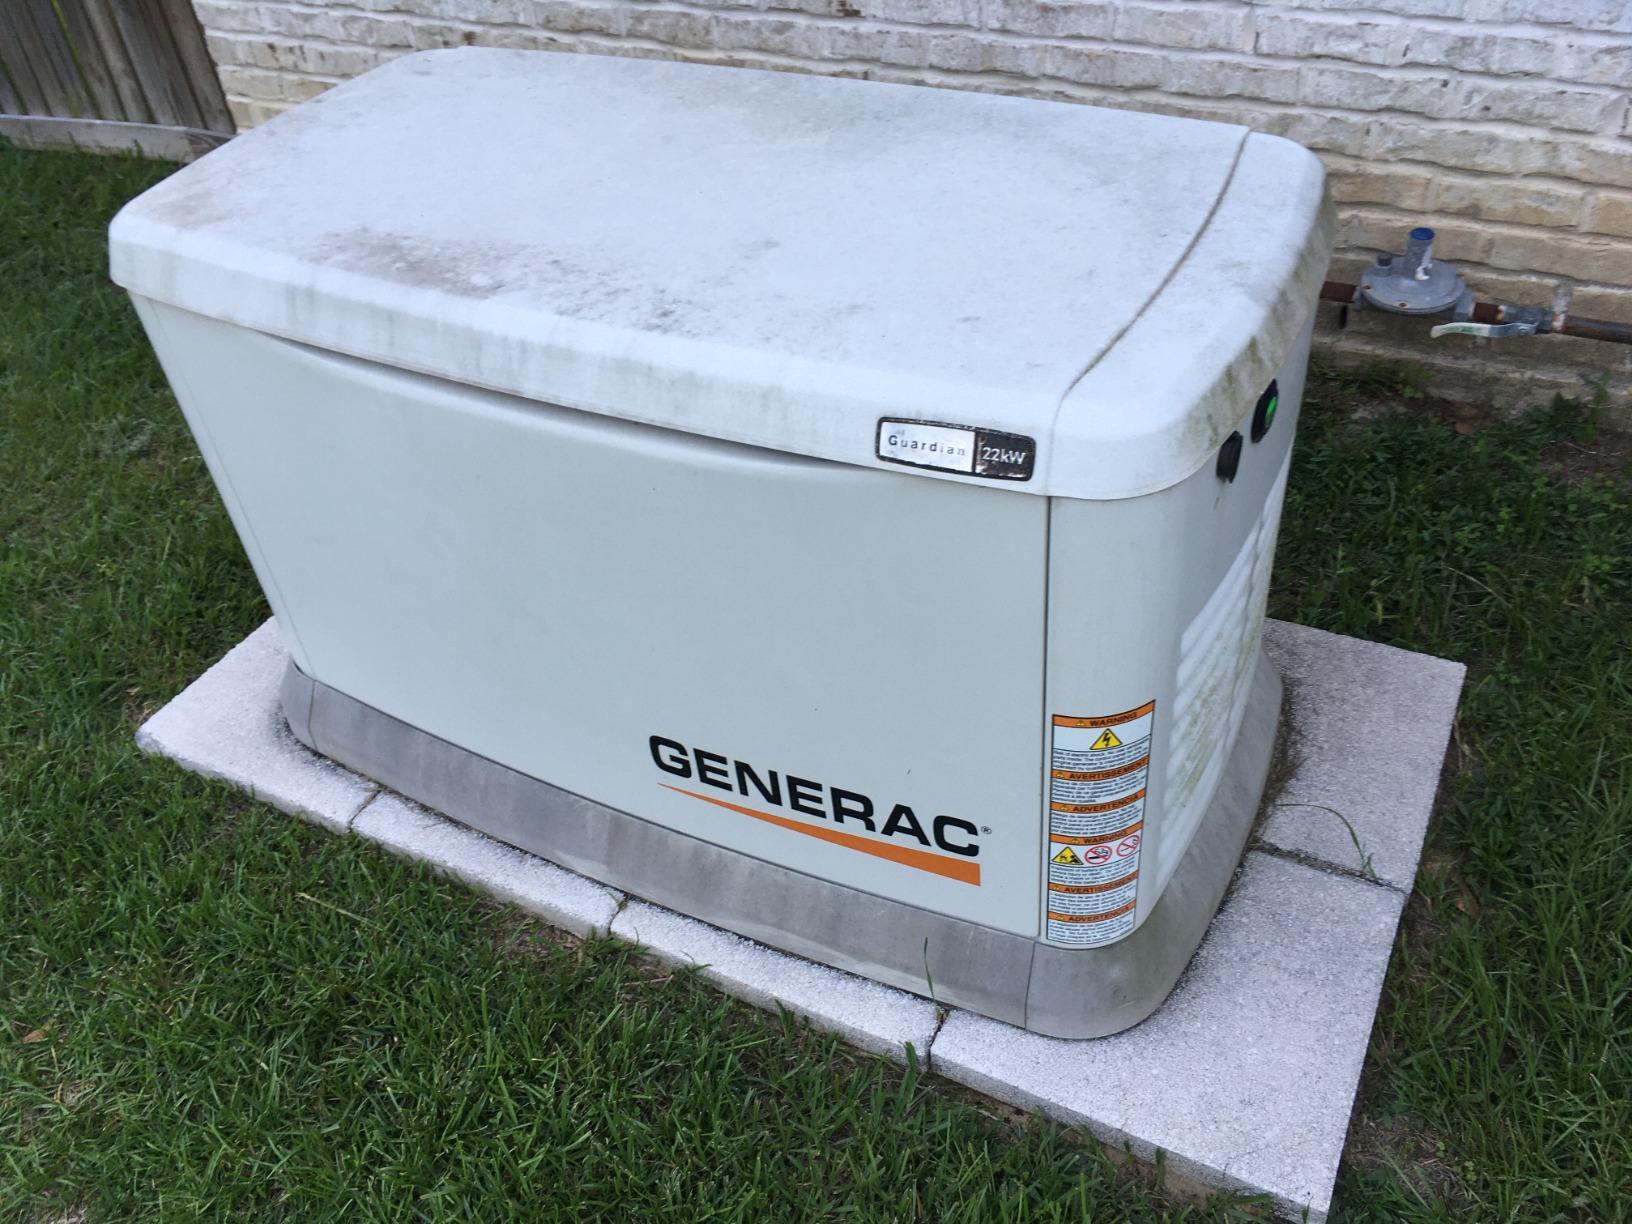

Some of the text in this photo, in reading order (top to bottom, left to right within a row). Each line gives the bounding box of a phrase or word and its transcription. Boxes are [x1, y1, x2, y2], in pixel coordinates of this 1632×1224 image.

[888, 435, 1026, 465] Guardian 22kW
[1089, 711, 1137, 726] WARNING
[1069, 758, 1147, 779] AVERTISSEMENT
[649, 735, 980, 857] GENERAC
[1072, 794, 1139, 812] ADVERTENCIA
[1083, 830, 1127, 844] WARNING
